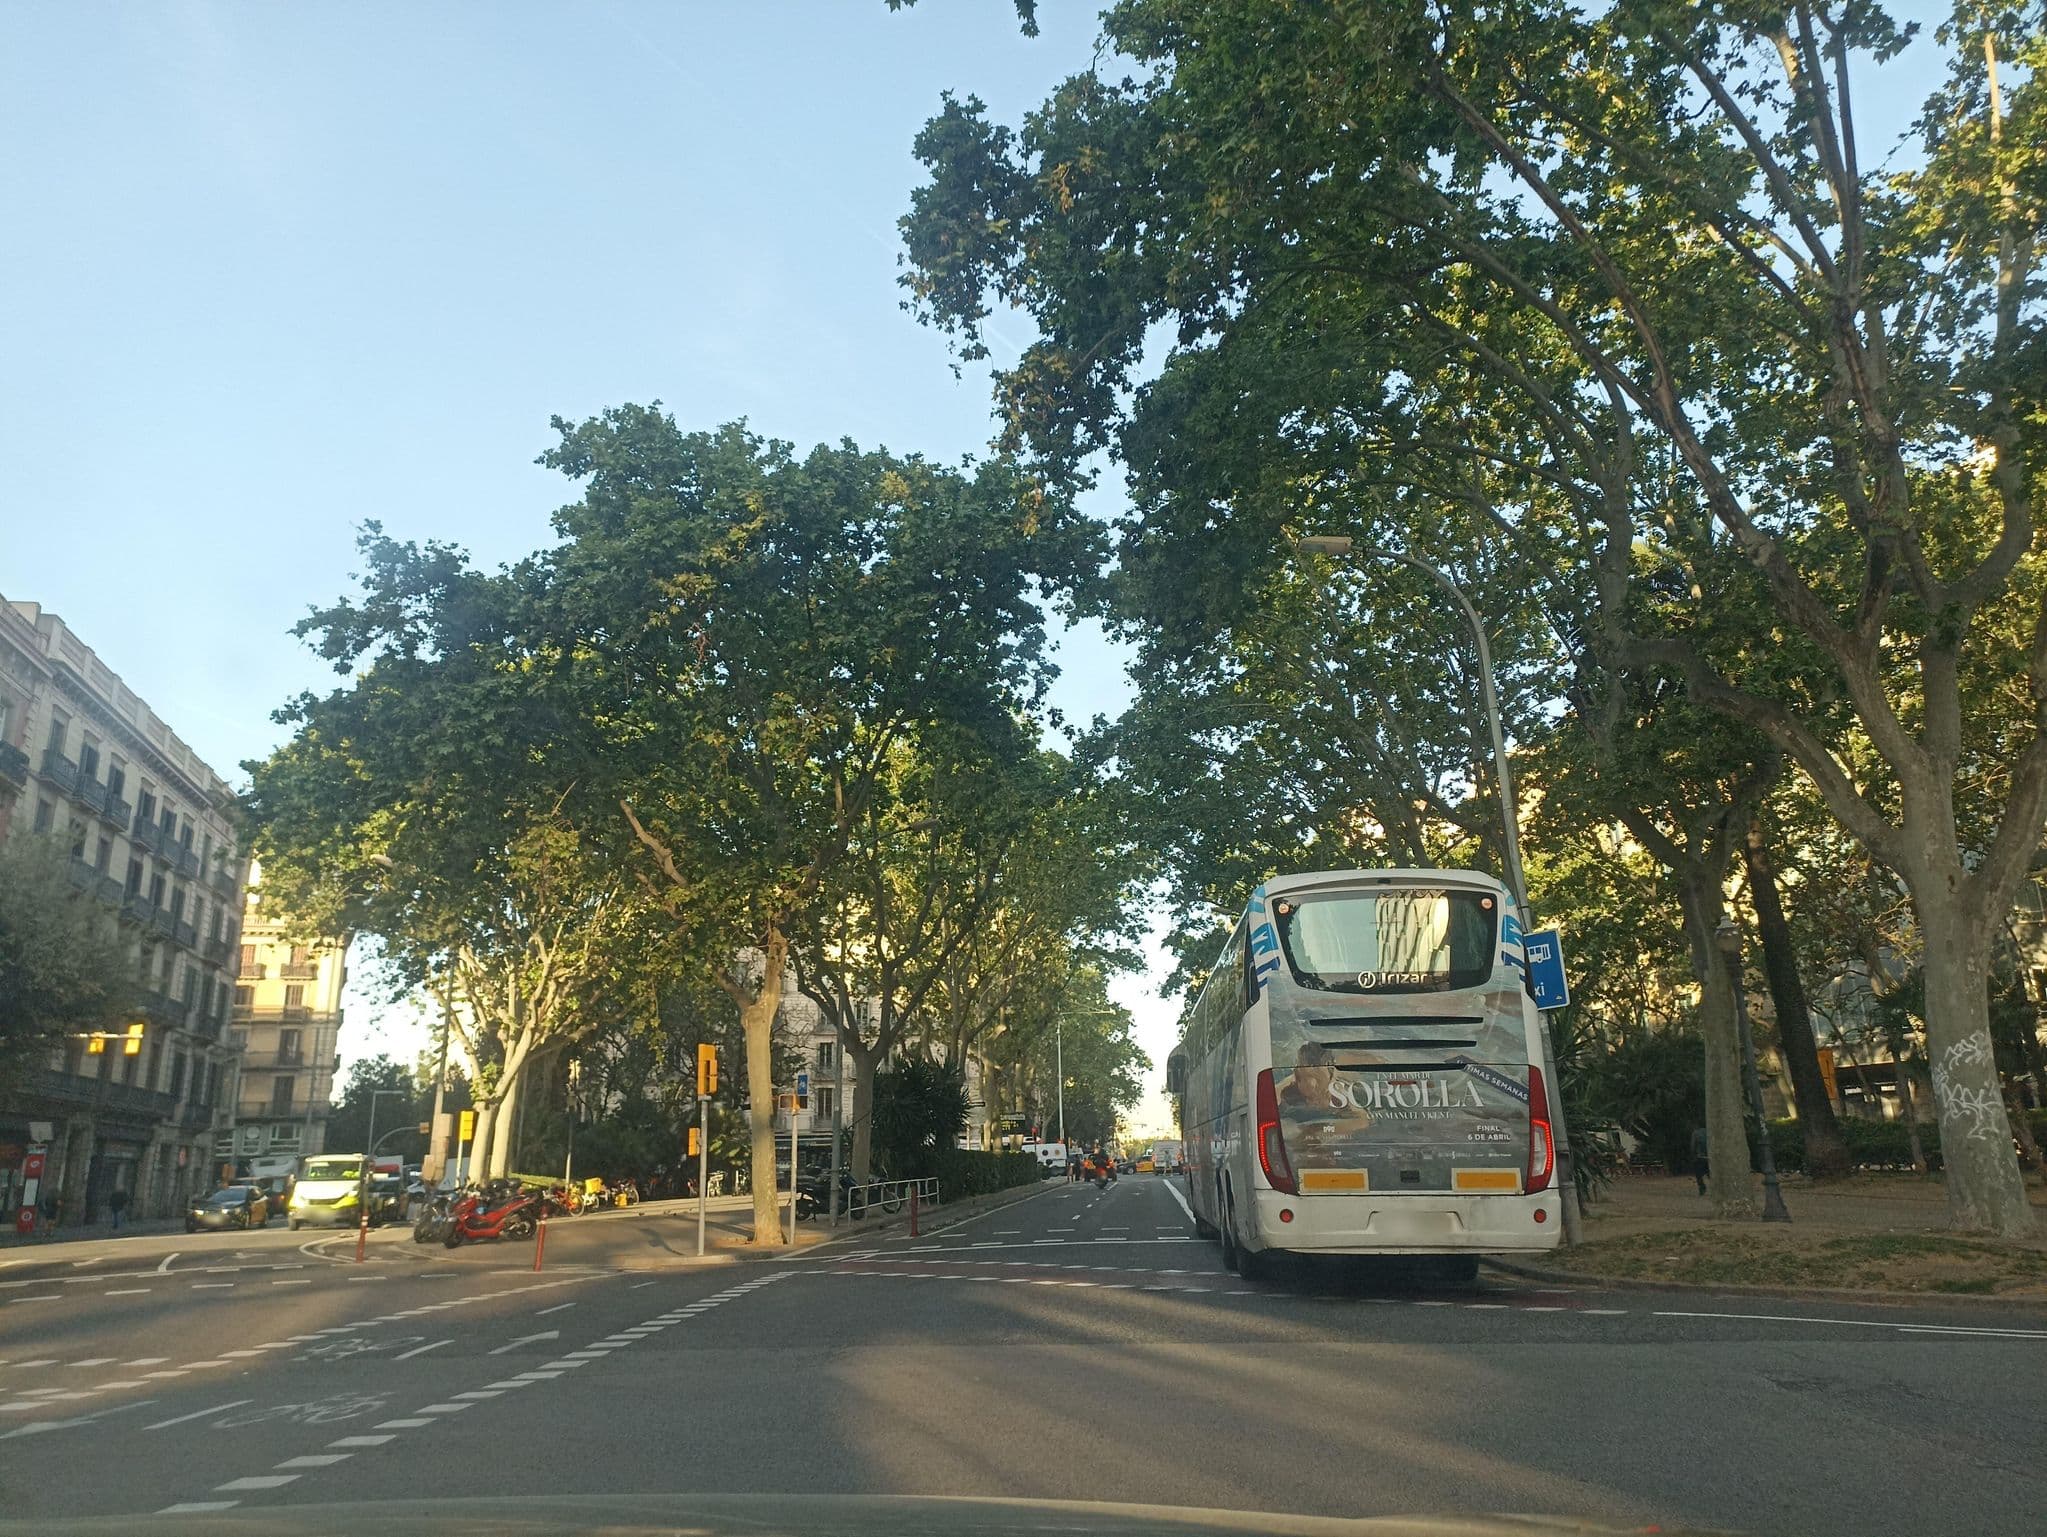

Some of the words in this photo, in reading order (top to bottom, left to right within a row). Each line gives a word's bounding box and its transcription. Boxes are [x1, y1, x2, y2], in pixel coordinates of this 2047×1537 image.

[1381, 972, 1428, 985] Irizar
[1534, 982, 1545, 997] xi
[1328, 1079, 1484, 1109] SOROLLA
[1490, 1077, 1529, 1101] SEMANAS
[1385, 1111, 1419, 1120] MANUEL
